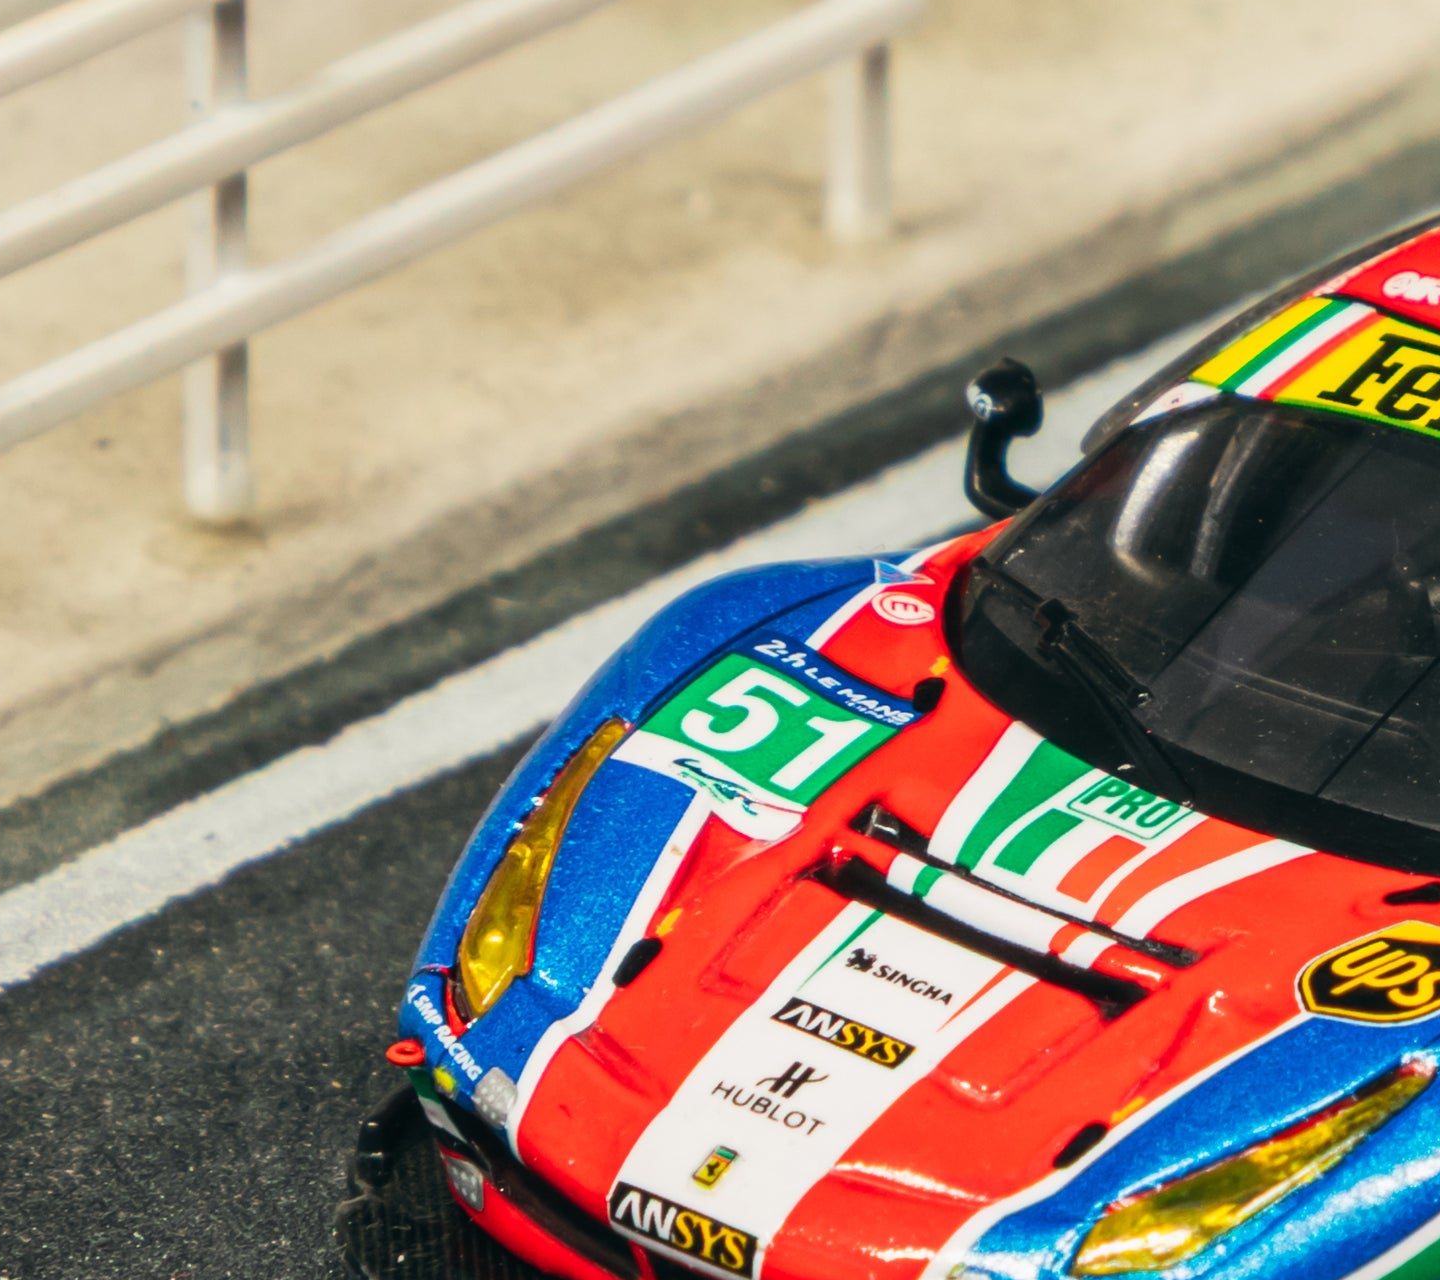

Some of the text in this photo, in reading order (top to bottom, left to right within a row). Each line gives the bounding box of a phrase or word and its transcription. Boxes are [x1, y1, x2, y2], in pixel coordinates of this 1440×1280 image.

[680, 667, 873, 792] 51
[1082, 776, 1180, 828] PRO
[873, 964, 953, 1005] SINGHA
[413, 995, 483, 1081] SMP RACING
[779, 1004, 906, 1064] ANSYS
[712, 1081, 826, 1135] HUBLOT
[615, 1190, 748, 1270] ANSYS
